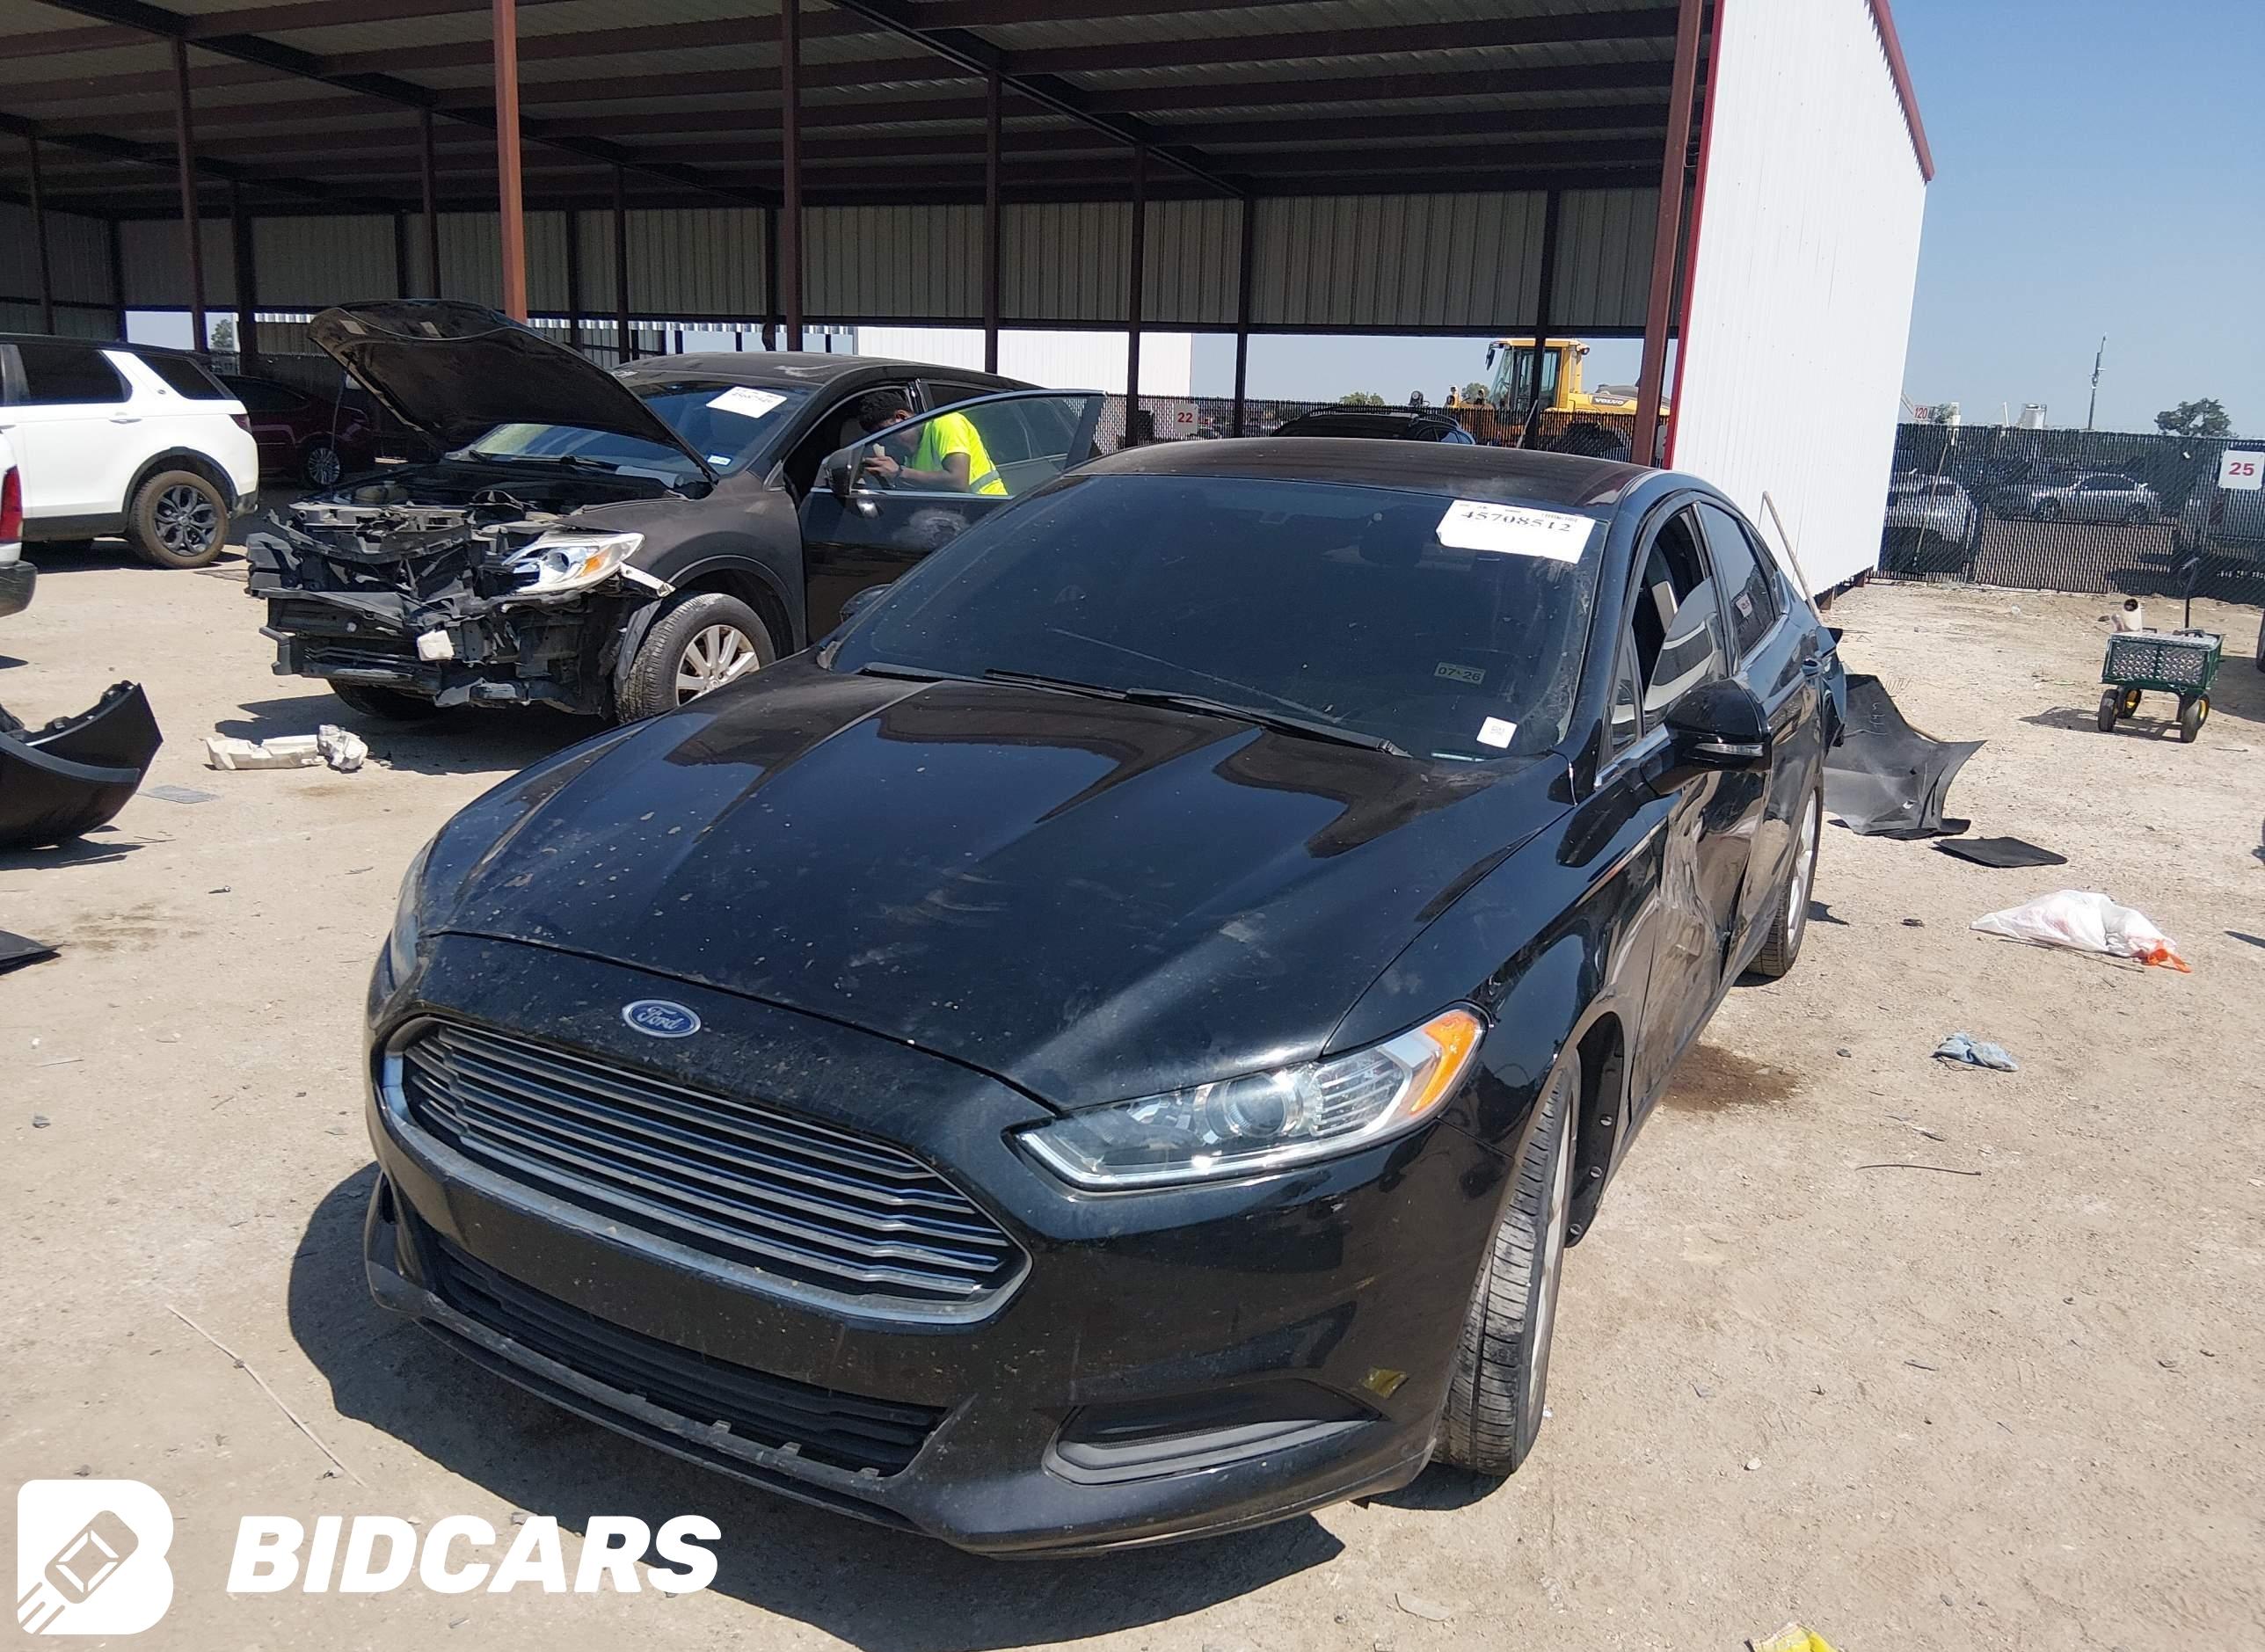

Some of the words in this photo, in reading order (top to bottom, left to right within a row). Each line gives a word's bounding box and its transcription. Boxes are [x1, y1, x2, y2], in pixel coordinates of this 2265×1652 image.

[1177, 411, 1193, 423] 22
[2228, 462, 2255, 477] 25
[1460, 510, 1572, 533] 45708512
[636, 1006, 685, 1030] Ford
